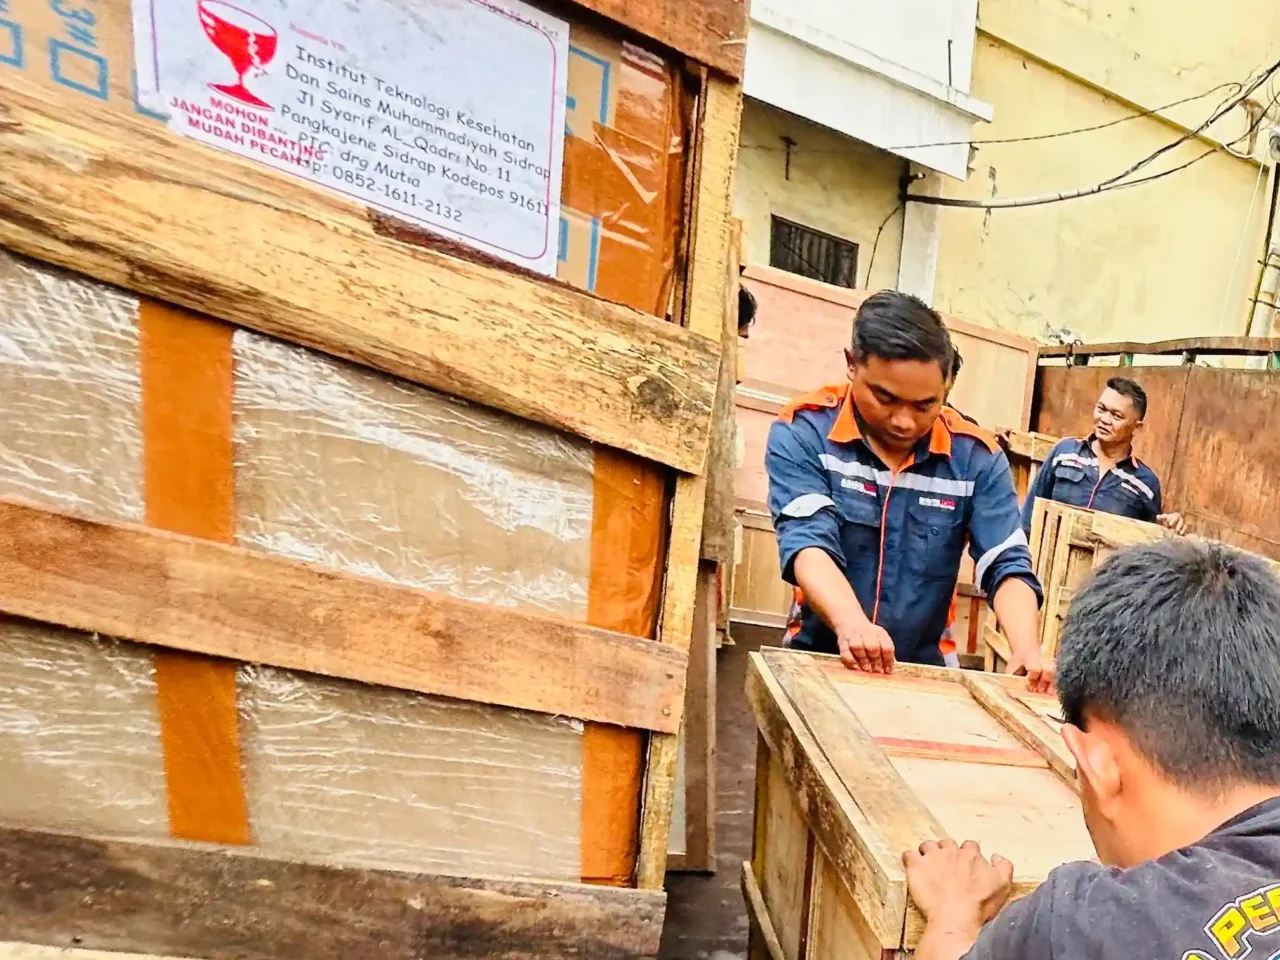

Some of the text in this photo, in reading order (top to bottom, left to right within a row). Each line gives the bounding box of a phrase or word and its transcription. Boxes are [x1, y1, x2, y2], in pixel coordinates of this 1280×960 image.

[170, 97, 325, 162] JANGAN DIBANTING
[187, 115, 245, 146] MUDAH
[209, 96, 269, 127] MOHON
[286, 62, 551, 181] Dan Sains Muhammadiyah Sidrap
[296, 44, 535, 153] Institut Teknologi Kesehatan
[281, 103, 549, 217] Pangkajene Sidrap Kodepos 91611
[321, 100, 376, 130] Syarif
[497, 167, 511, 183] 11
[340, 149, 369, 171] drg
[374, 161, 421, 188] Mutia
[332, 165, 463, 223] 0852-1611-2132
